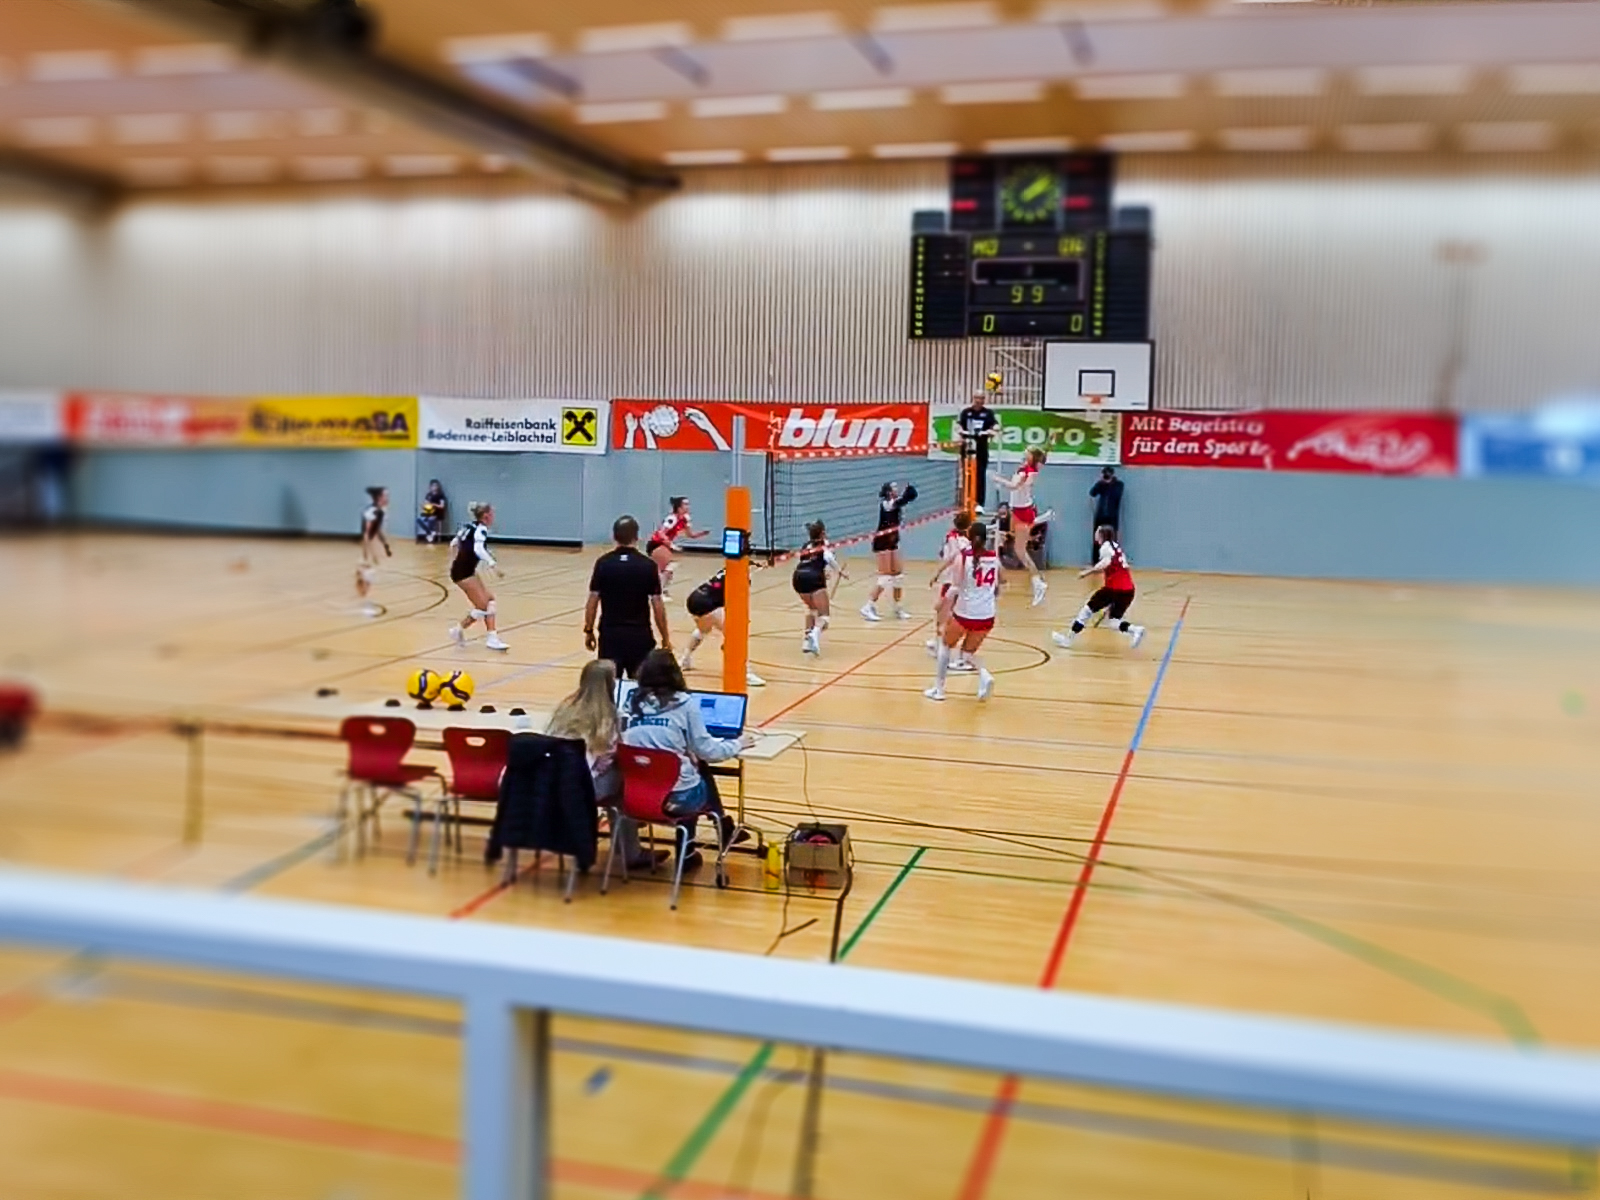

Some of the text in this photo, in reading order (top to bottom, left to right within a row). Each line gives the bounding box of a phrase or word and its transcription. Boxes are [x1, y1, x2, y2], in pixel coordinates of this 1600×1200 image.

[983, 315, 1082, 332] 0 0
[465, 417, 557, 431] Raiffeisenbank
[779, 408, 914, 448] blum
[1129, 416, 1164, 431] Mit
[428, 428, 557, 444] Bodensee-Leiblachtal
[1128, 436, 1162, 457] für
[1164, 437, 1200, 454] den
[975, 567, 996, 588] 14
